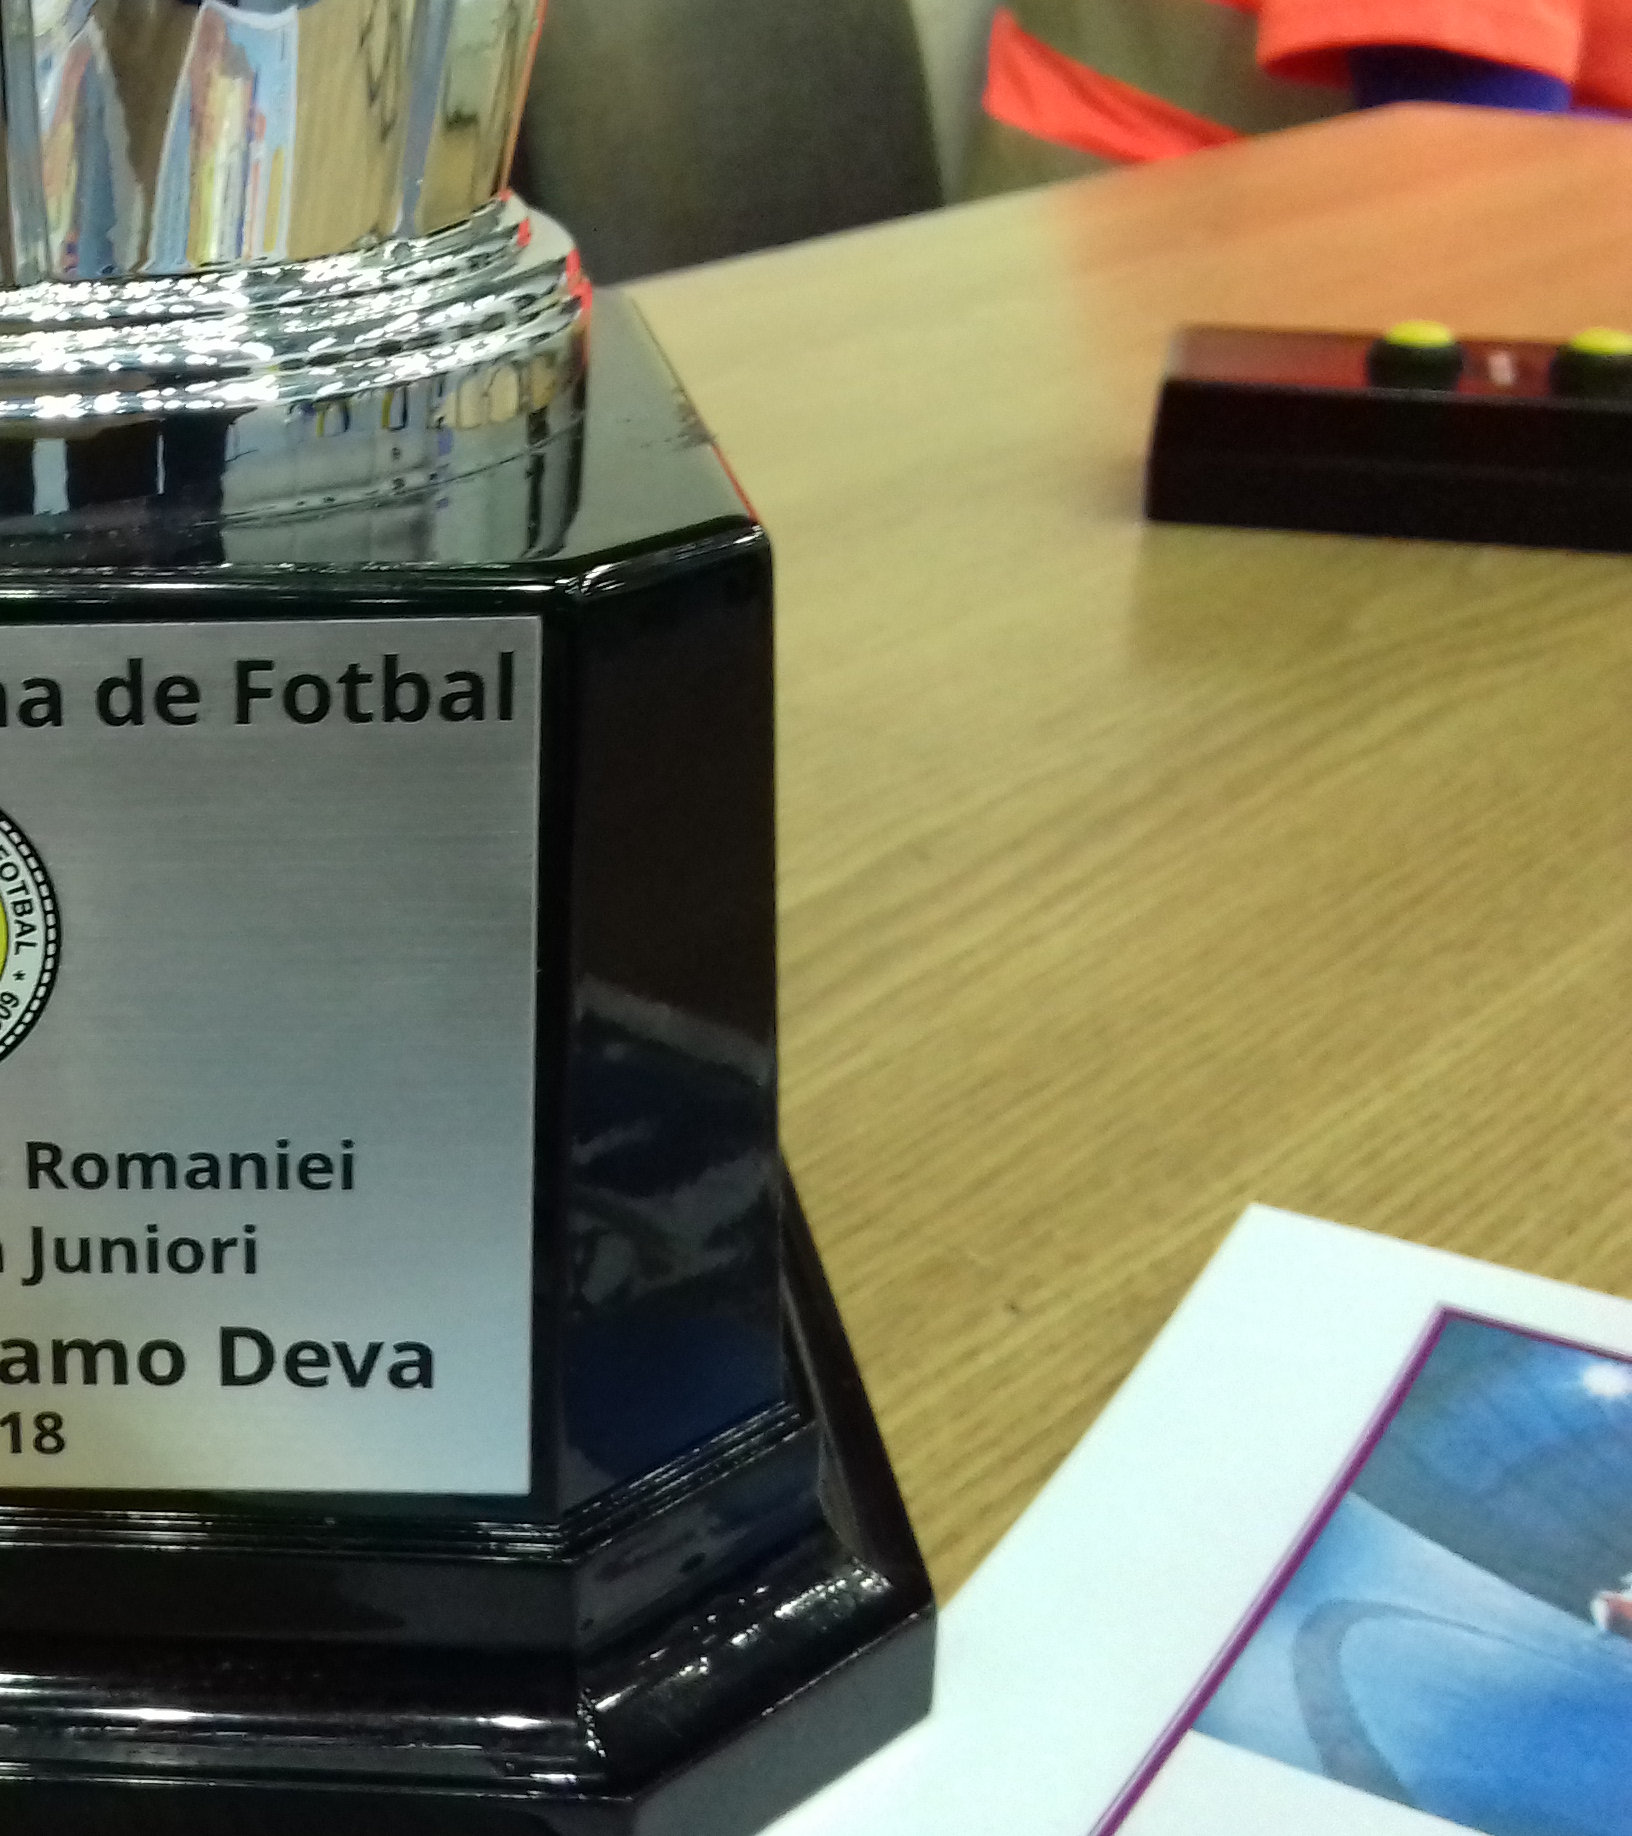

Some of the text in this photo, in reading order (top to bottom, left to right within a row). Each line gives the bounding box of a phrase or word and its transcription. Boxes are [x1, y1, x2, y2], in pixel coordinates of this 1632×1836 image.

[94, 658, 203, 728] de
[233, 650, 516, 728] Fotbal
[24, 1138, 356, 1191] Romaniei
[21, 1223, 258, 1287] Juniori
[219, 1325, 434, 1390] Deva
